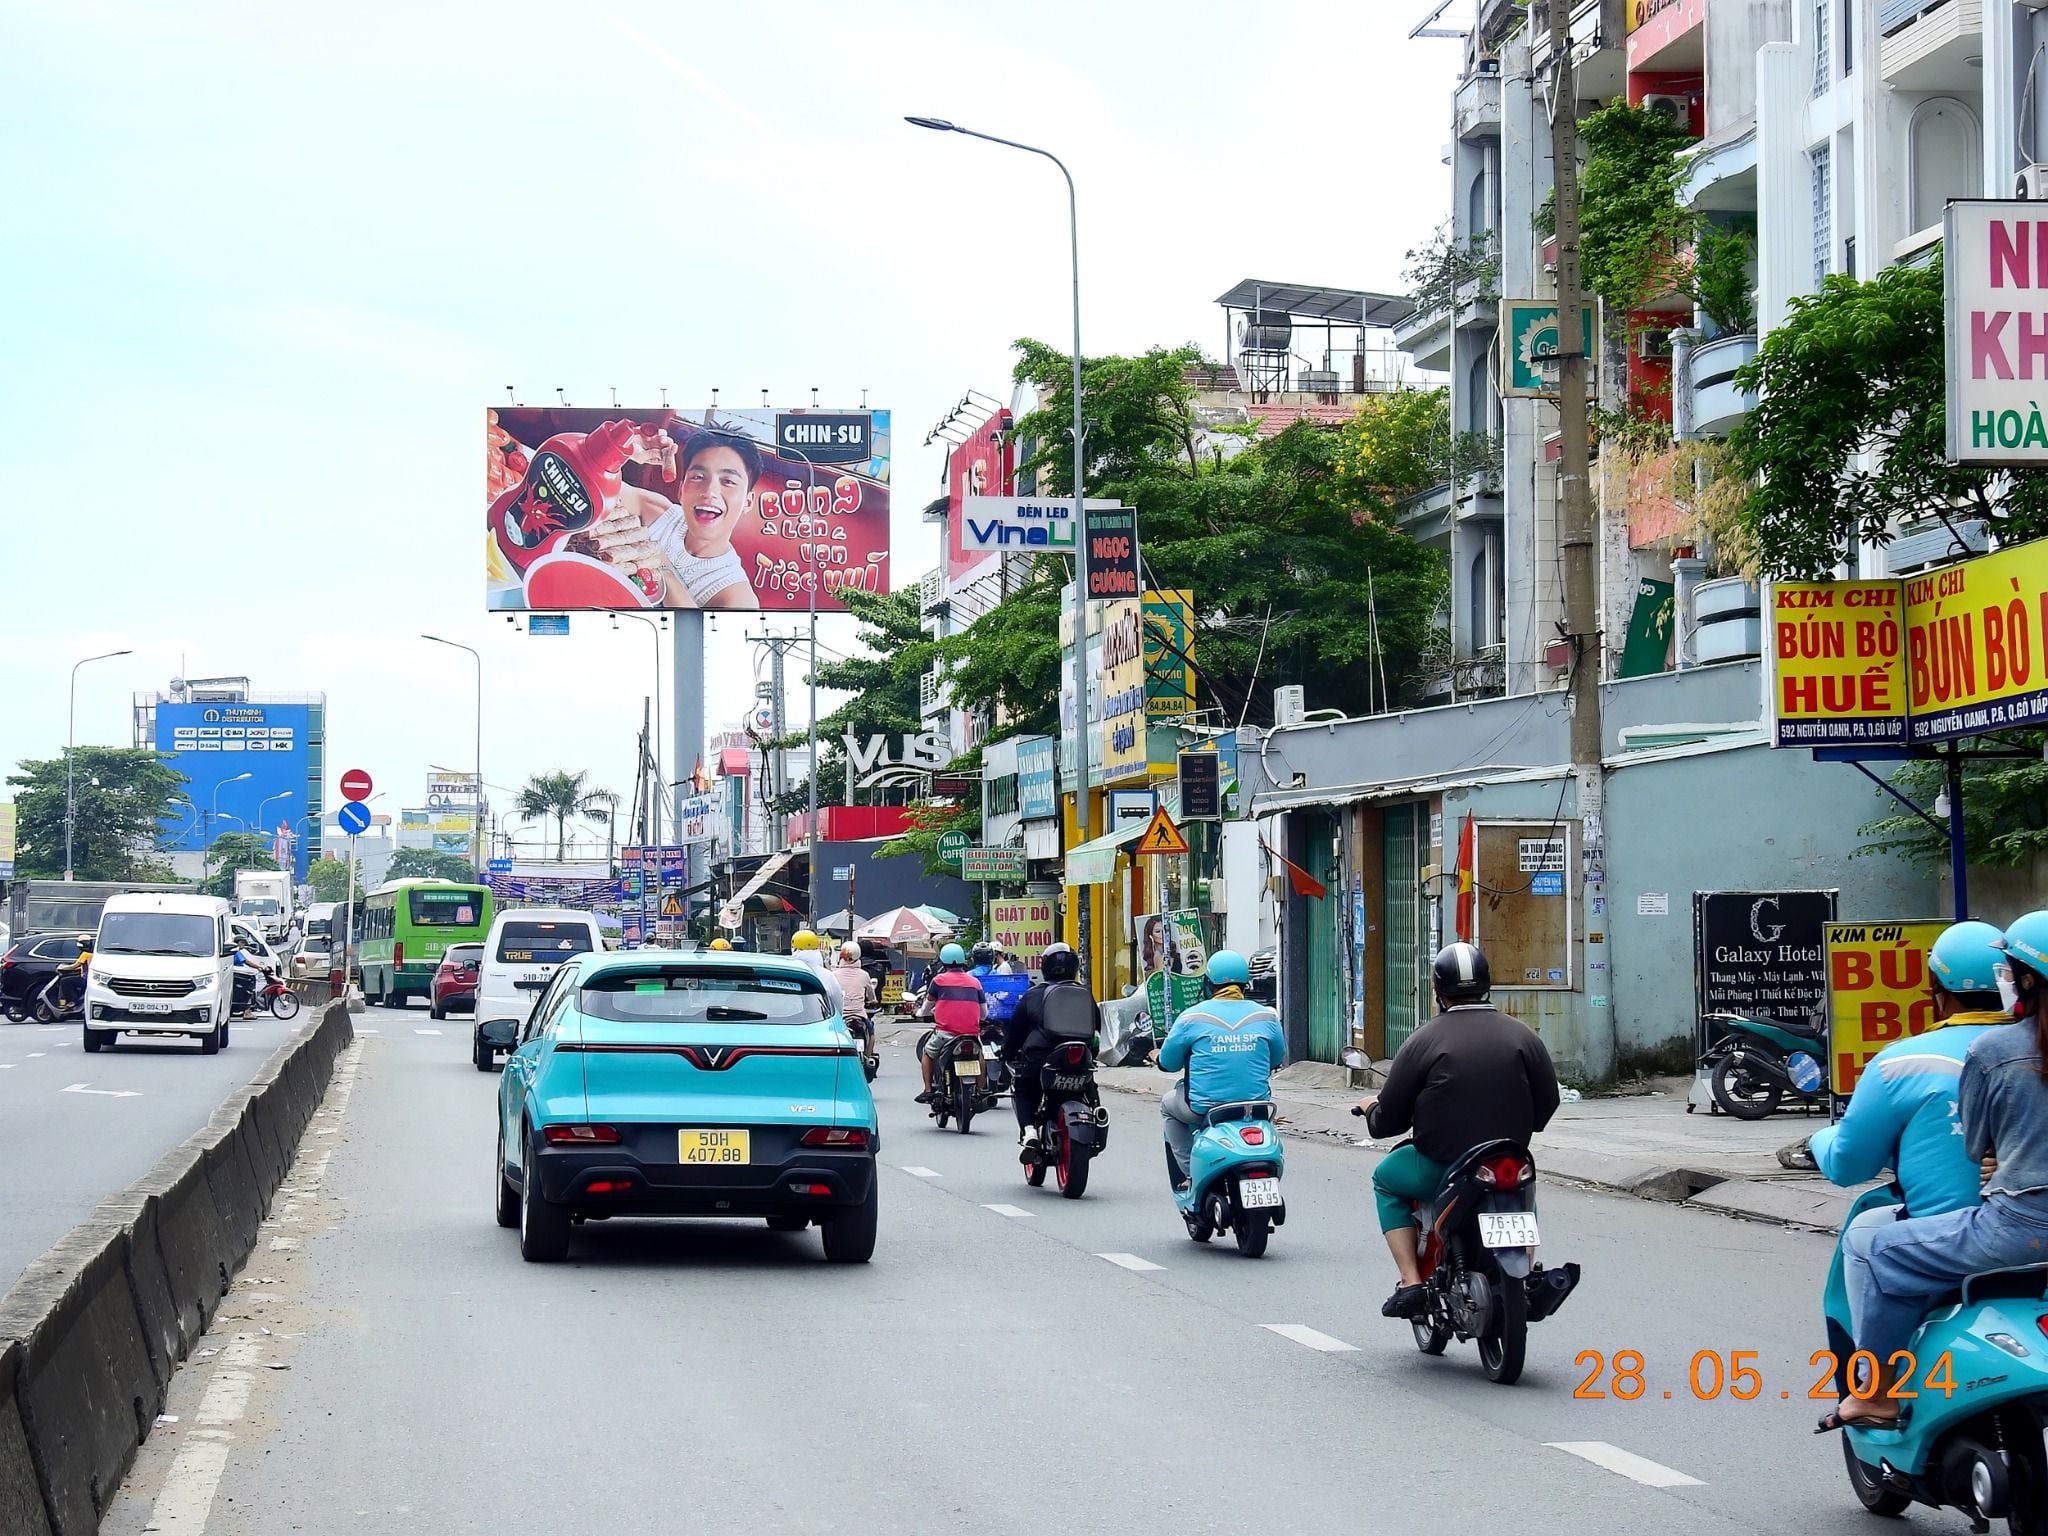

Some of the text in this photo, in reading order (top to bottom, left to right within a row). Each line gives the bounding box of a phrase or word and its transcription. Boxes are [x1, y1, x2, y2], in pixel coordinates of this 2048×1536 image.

[784, 424, 862, 443] CHIN-SU
[544, 456, 588, 512] CHIN-SU
[1046, 506, 1069, 518] LED
[1093, 536, 1129, 564] NGỌC
[1907, 568, 1965, 606] KIM CHI
[1776, 588, 1898, 608] KIM CHI
[1777, 611, 1899, 659] BÚN BÒ
[1909, 577, 2031, 707] BÚN BÒ
[1783, 661, 1896, 713] HUẾ
[1781, 725, 1796, 738] 592
[1796, 719, 1827, 737] NGUYỄN
[1914, 721, 1929, 738] 592
[1930, 710, 1963, 735] NGUYỄN
[1964, 709, 1990, 729] OANH,
[840, 732, 952, 774] VUS
[943, 836, 965, 847] HULA
[995, 903, 1026, 924] GIẶT
[1024, 928, 1052, 946] KHÔ
[1831, 927, 1903, 943] KIM CHI
[504, 952, 533, 960] TRUE
[1715, 944, 1822, 965] Galaxy Hotel
[1832, 940, 1933, 991] BÚ
[1710, 972, 1736, 984] Thang
[1738, 971, 1756, 984] Máy
[1763, 971, 1781, 984] Máy
[1783, 971, 1804, 984] Lạnh
[1727, 988, 1753, 1002] Phòng
[1760, 986, 1782, 999] Thiết
[1797, 988, 1813, 1001] Độc
[1778, 1005, 1799, 1017] Thuê
[1211, 1045, 1227, 1053] xin
[699, 1132, 729, 1146] 50H
[687, 1148, 741, 1163] 407.88
[1245, 1181, 1272, 1194] 29-X7
[1244, 1193, 1279, 1207] 736.95
[1488, 1216, 1526, 1230] 76-F1
[1486, 1230, 1536, 1245] 271.33
